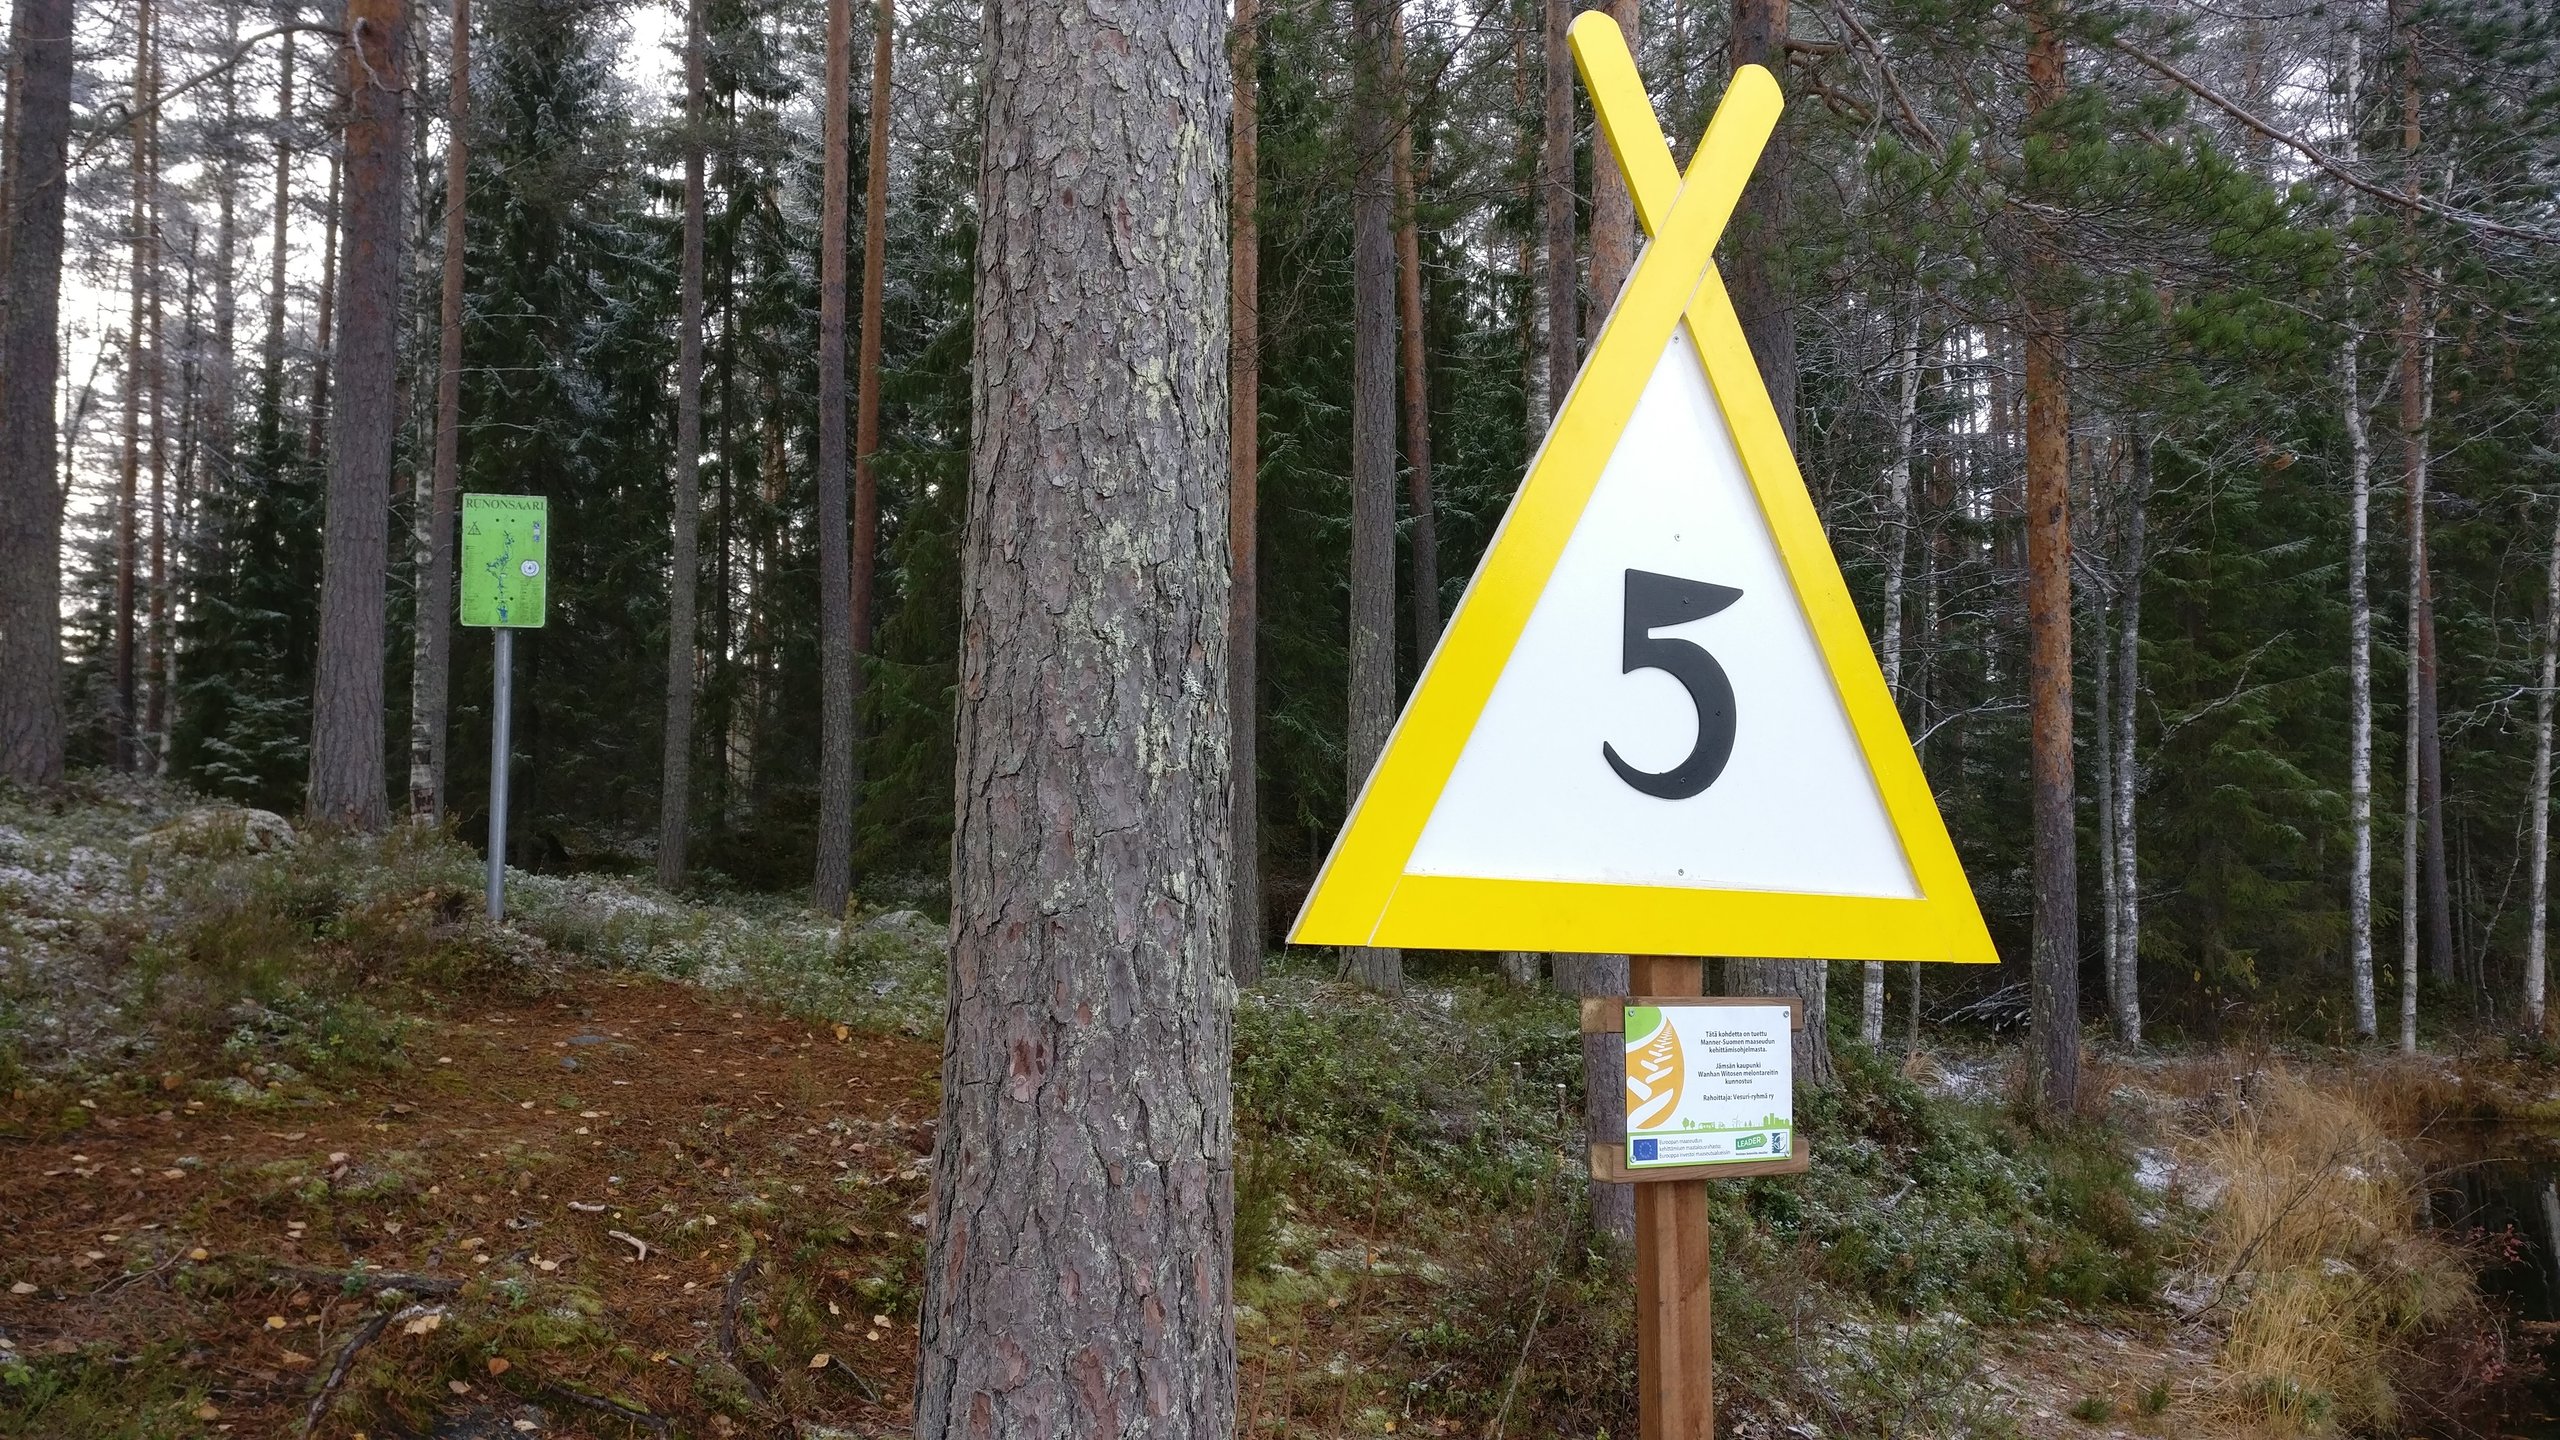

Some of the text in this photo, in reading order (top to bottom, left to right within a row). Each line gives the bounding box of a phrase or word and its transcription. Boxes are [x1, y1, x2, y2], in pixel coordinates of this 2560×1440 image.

[465, 498, 544, 510] RUNONSAARI
[1603, 568, 1744, 800] 5
[1709, 1046, 1767, 1054] kehittämisohjelmasta.
[1736, 1062, 1761, 1070] kaupunki
[1703, 1094, 1732, 1102] Rahoittaja:
[1733, 1093, 1768, 1101] Vesuri-ryhmä
[1737, 1136, 1761, 1148] LEADER
